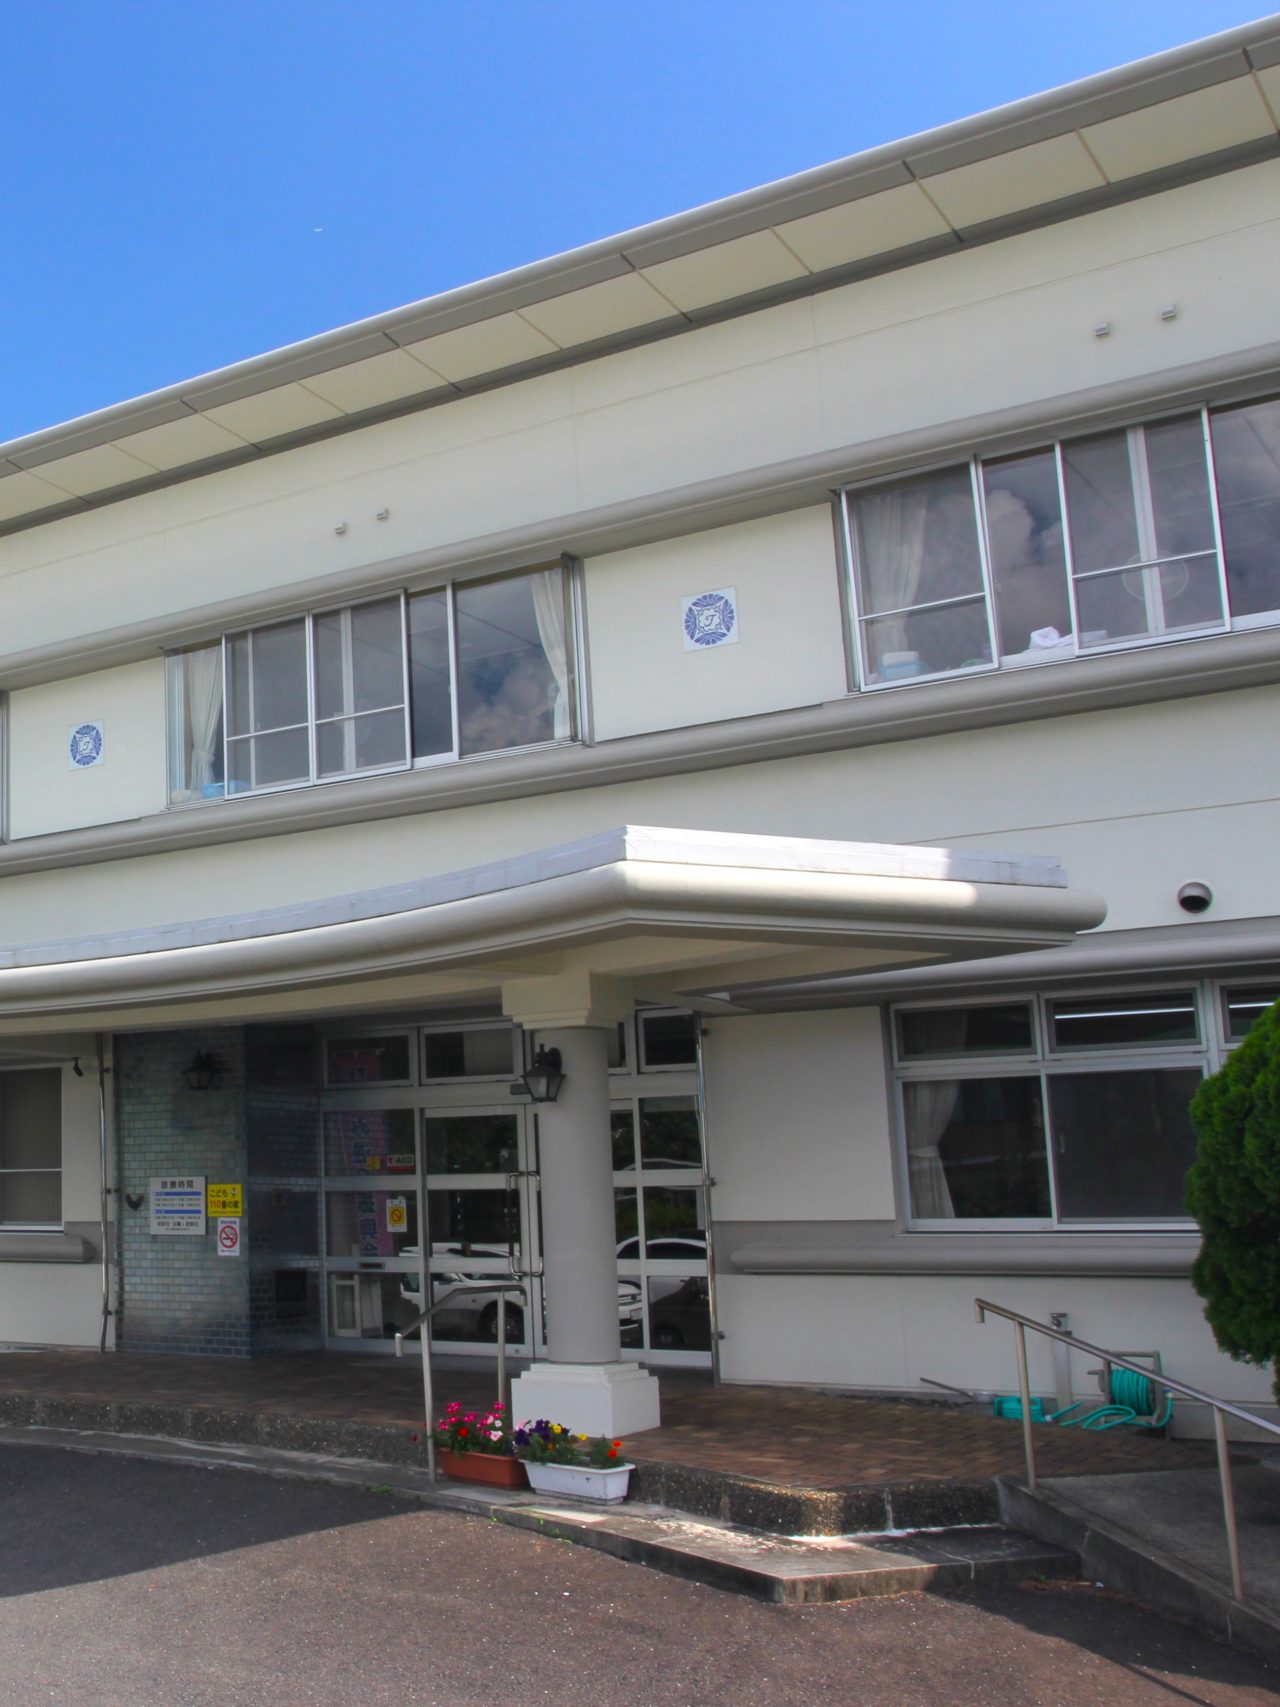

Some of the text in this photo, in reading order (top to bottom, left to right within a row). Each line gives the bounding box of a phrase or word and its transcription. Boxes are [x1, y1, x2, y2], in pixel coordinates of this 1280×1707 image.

[395, 1156, 413, 1164] AED
[161, 1180, 194, 1189] 診療時間
[210, 1188, 228, 1197] こども
[210, 1199, 239, 1209] 110番の家
